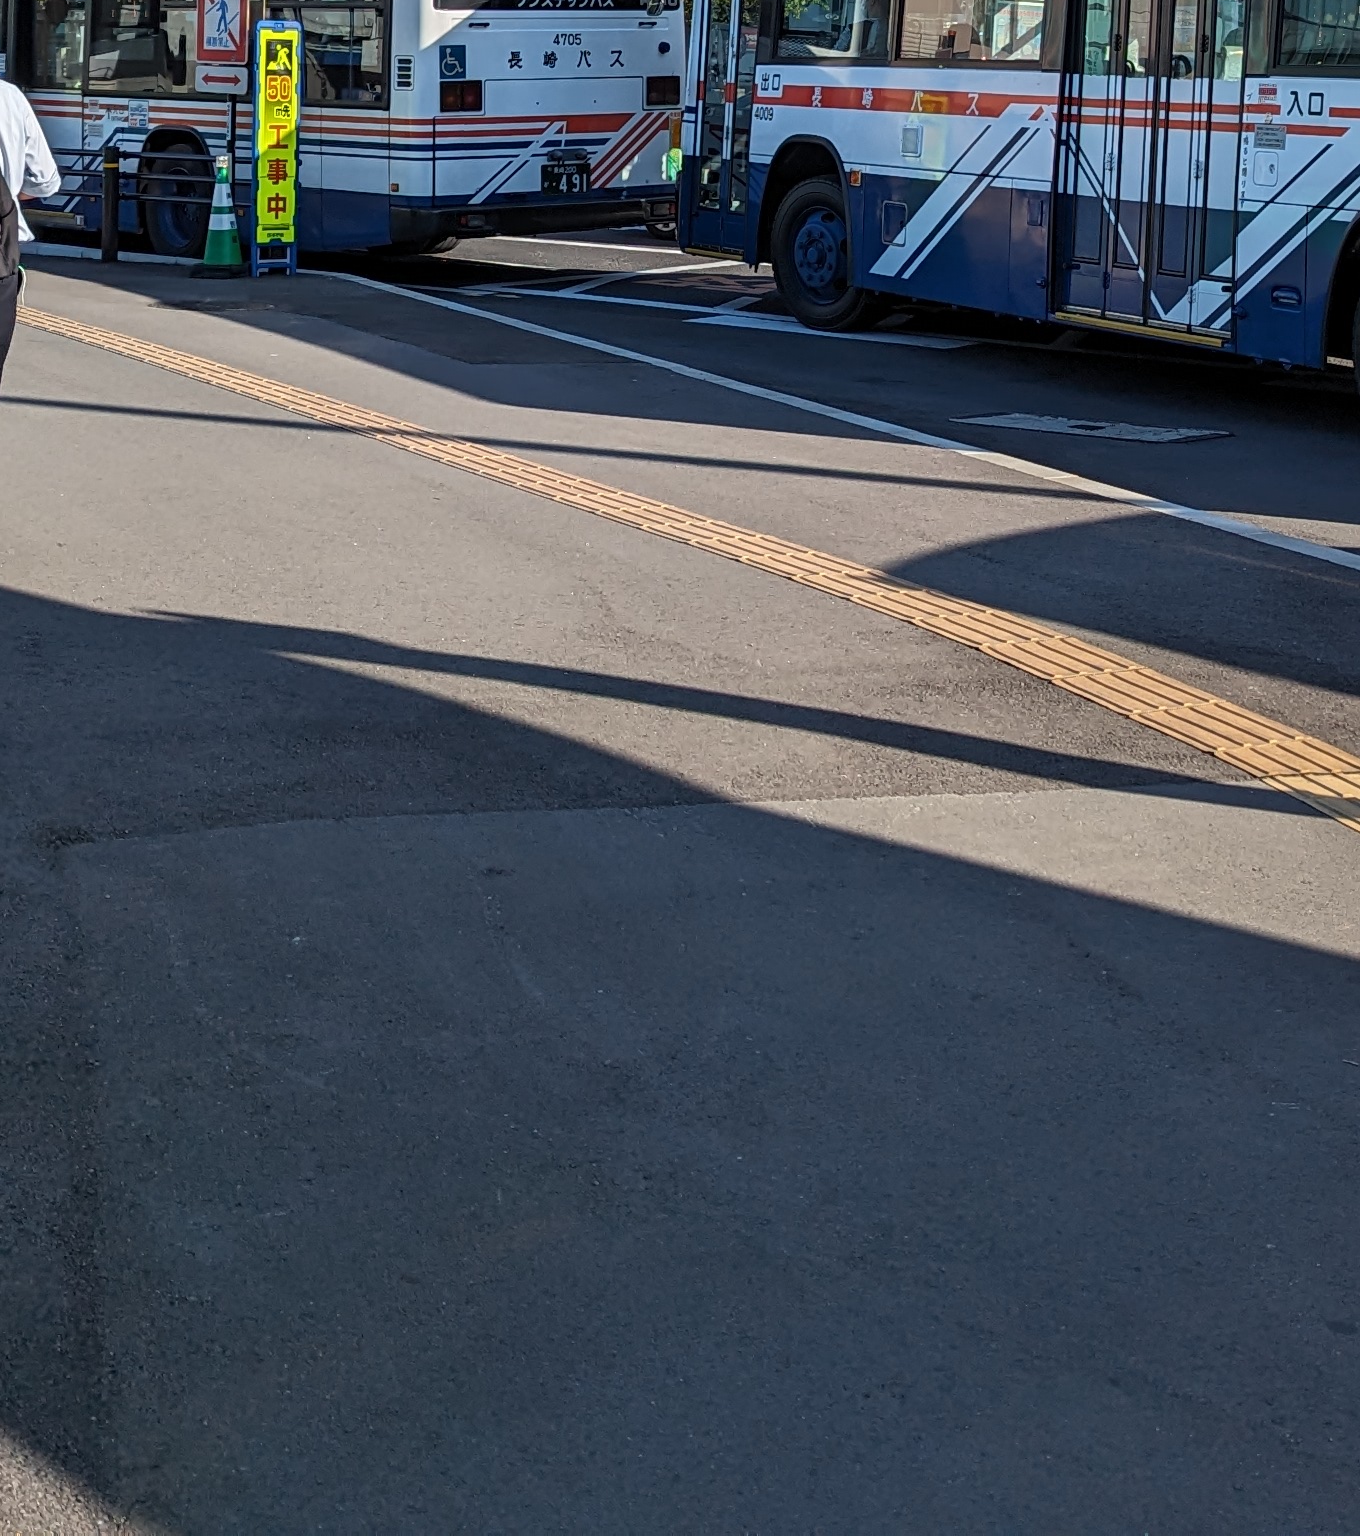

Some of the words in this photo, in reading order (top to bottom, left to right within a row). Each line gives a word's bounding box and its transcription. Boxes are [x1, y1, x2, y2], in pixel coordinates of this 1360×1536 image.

[553, 33, 582, 46] 4705
[508, 49, 625, 70] 長崎バス
[267, 75, 292, 102] 50
[760, 72, 782, 92] 出口
[811, 86, 980, 117] 長崎バス
[1286, 90, 1325, 117] 入口
[754, 107, 774, 121] 4009
[267, 124, 289, 220] 工事中
[559, 173, 587, 193] 491
